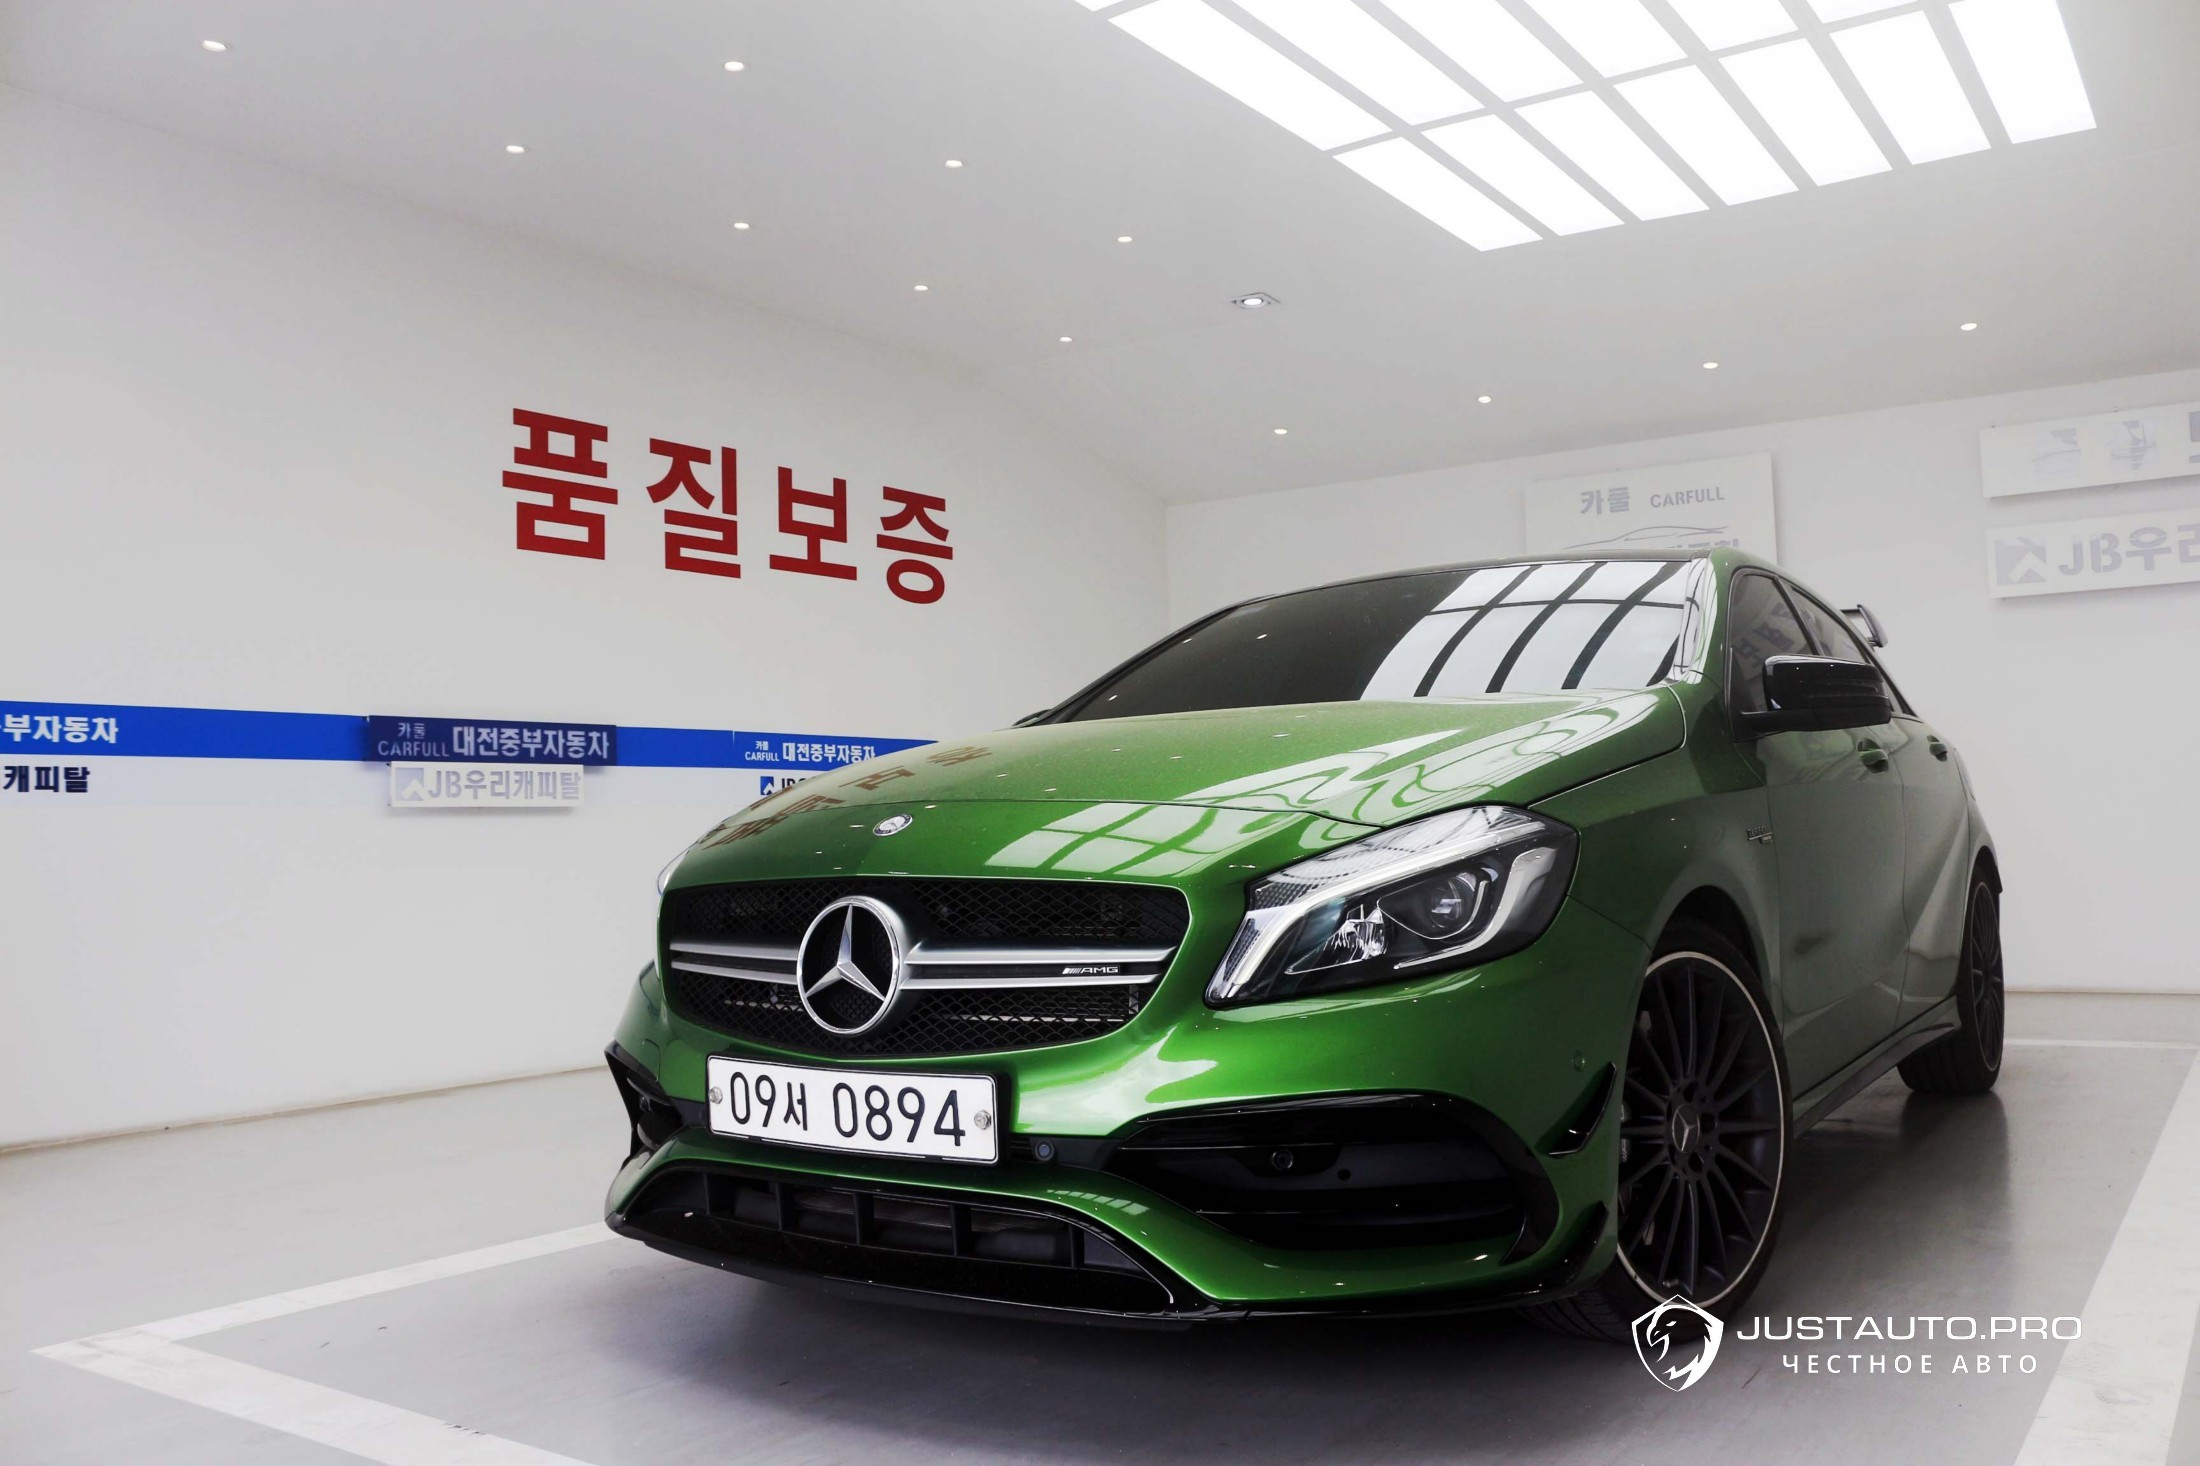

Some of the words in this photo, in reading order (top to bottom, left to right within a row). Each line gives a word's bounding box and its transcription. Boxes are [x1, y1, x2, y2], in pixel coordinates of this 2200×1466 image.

[502, 408, 953, 604] 품질보증
[1650, 487, 1725, 508] CARFULL
[0, 714, 119, 743] 부자동차
[452, 726, 609, 759] 대전중부자동차
[377, 741, 449, 757] CARFULL
[745, 751, 780, 762] CARFULL
[782, 742, 876, 764] 대전중부자동차
[3, 765, 91, 793] 캐피탈
[428, 769, 581, 800] JB우리캐피탈
[1080, 966, 1119, 974] AMG
[730, 1072, 808, 1131] 09서
[833, 1082, 966, 1147] 0894
